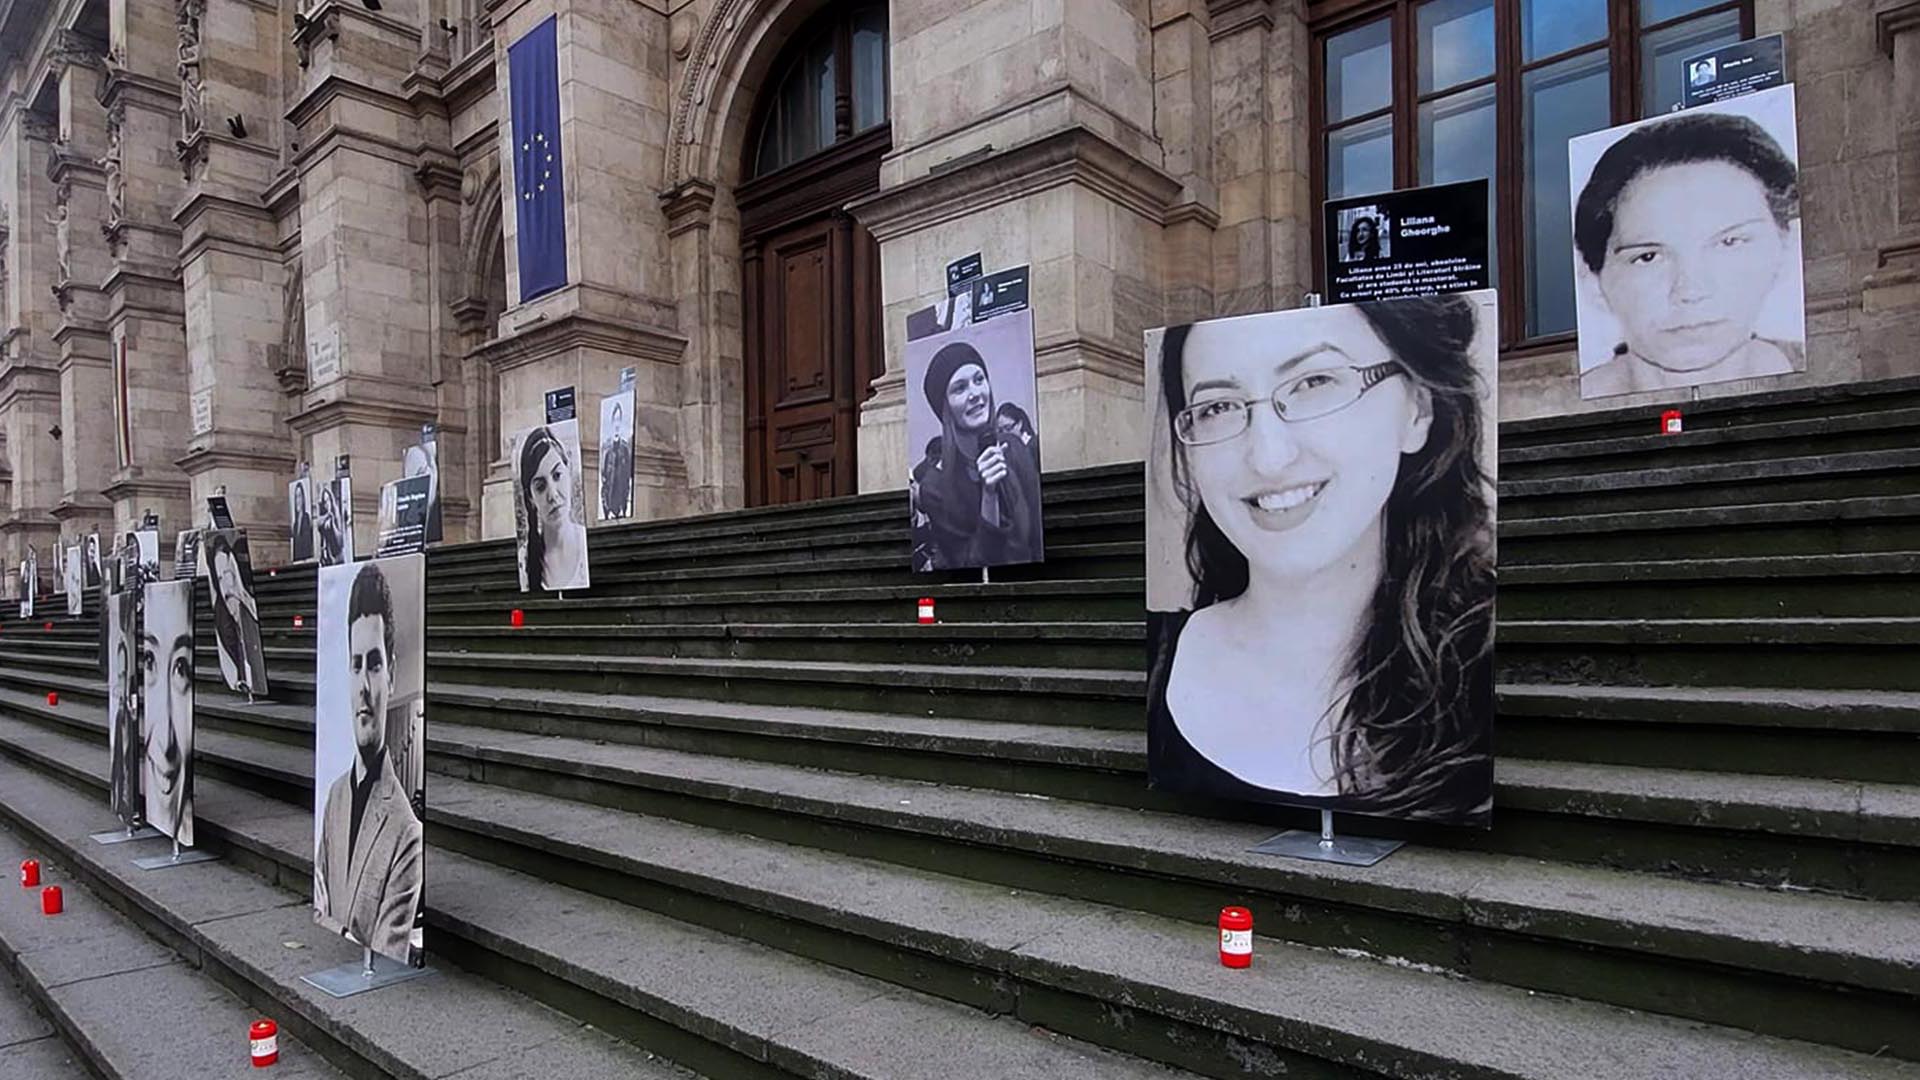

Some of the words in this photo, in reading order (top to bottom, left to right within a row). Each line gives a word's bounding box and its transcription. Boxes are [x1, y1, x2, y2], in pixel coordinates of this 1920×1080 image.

[1400, 215, 1435, 226] Liliana
[1400, 224, 1450, 237] Gheorghe
[1348, 267, 1373, 275] Liliana
[1336, 275, 1373, 284] Facultatea
